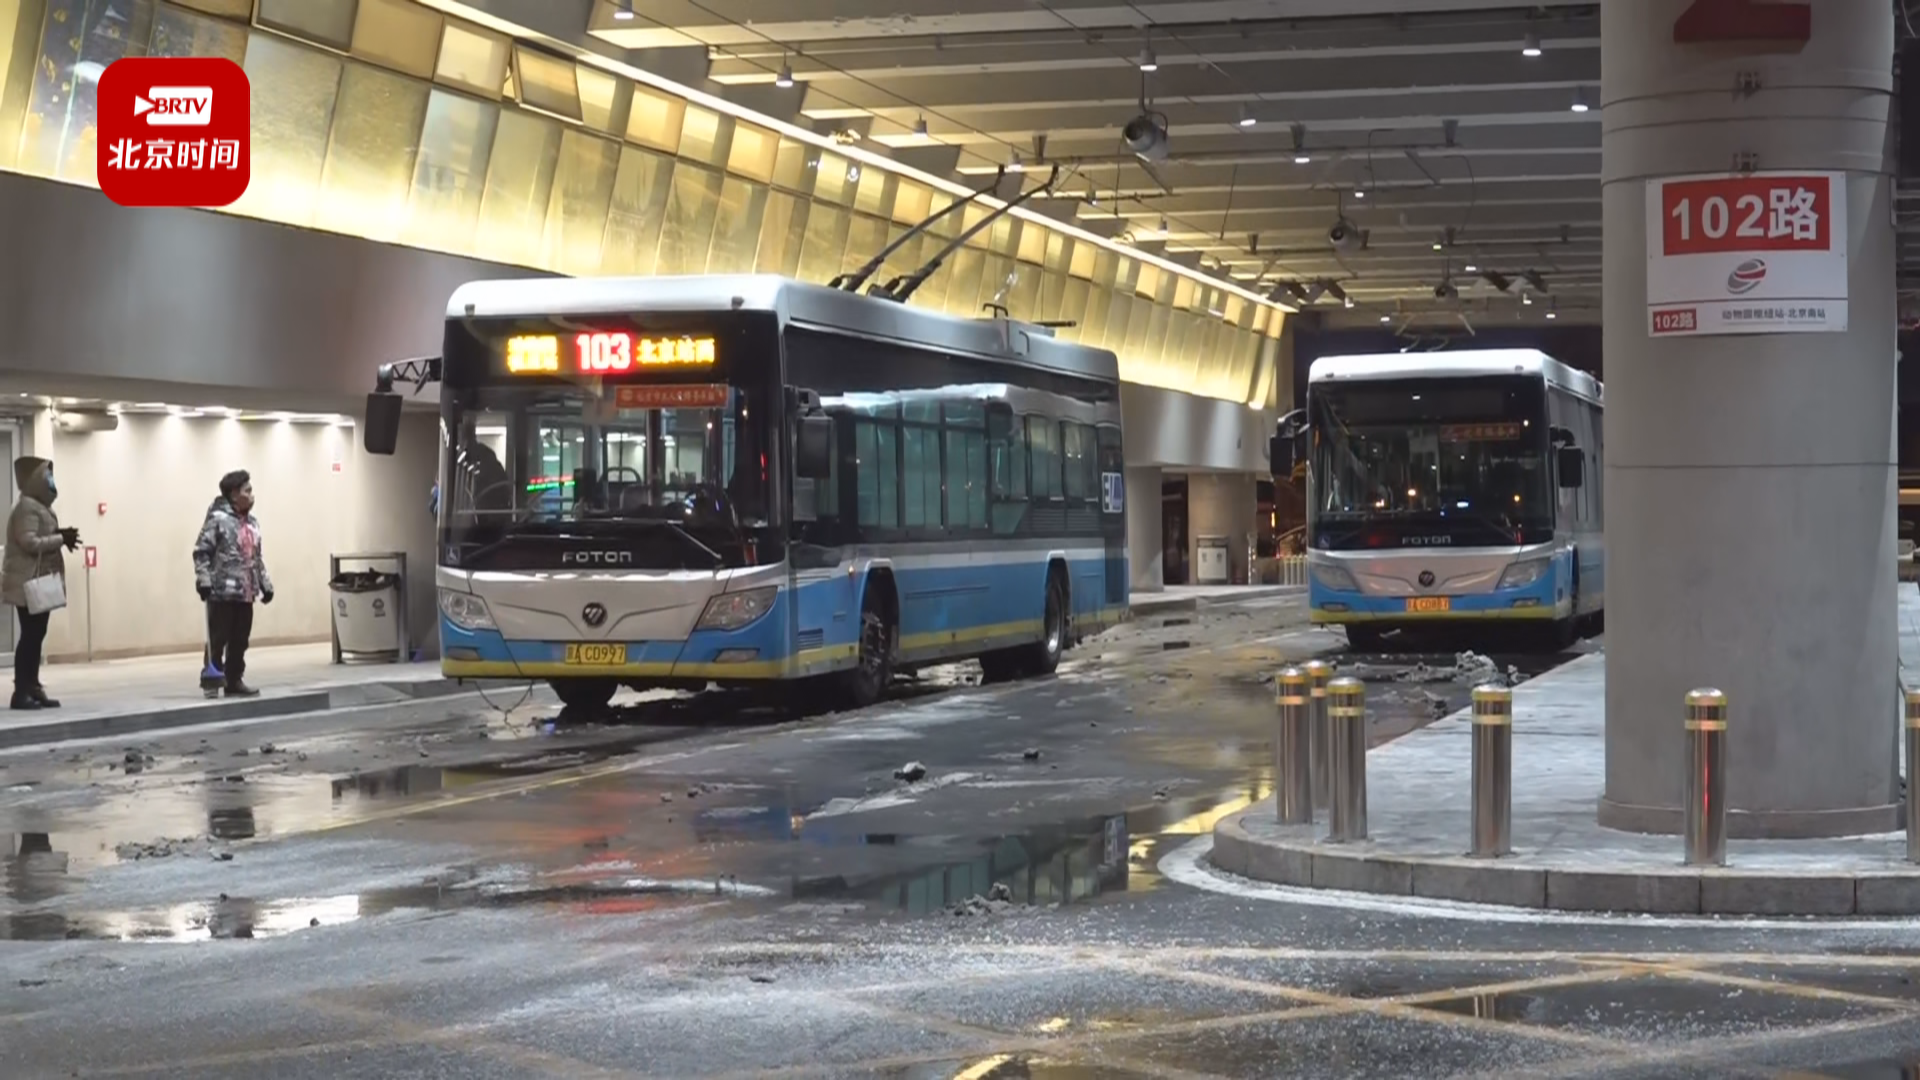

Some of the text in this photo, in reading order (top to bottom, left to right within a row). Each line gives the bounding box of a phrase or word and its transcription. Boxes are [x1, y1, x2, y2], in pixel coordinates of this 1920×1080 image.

[1672, 187, 1819, 241] 102路
[1655, 311, 1694, 329] 102路
[576, 332, 631, 370] 103
[1402, 535, 1451, 545] FOTON
[562, 550, 632, 563] FOTON
